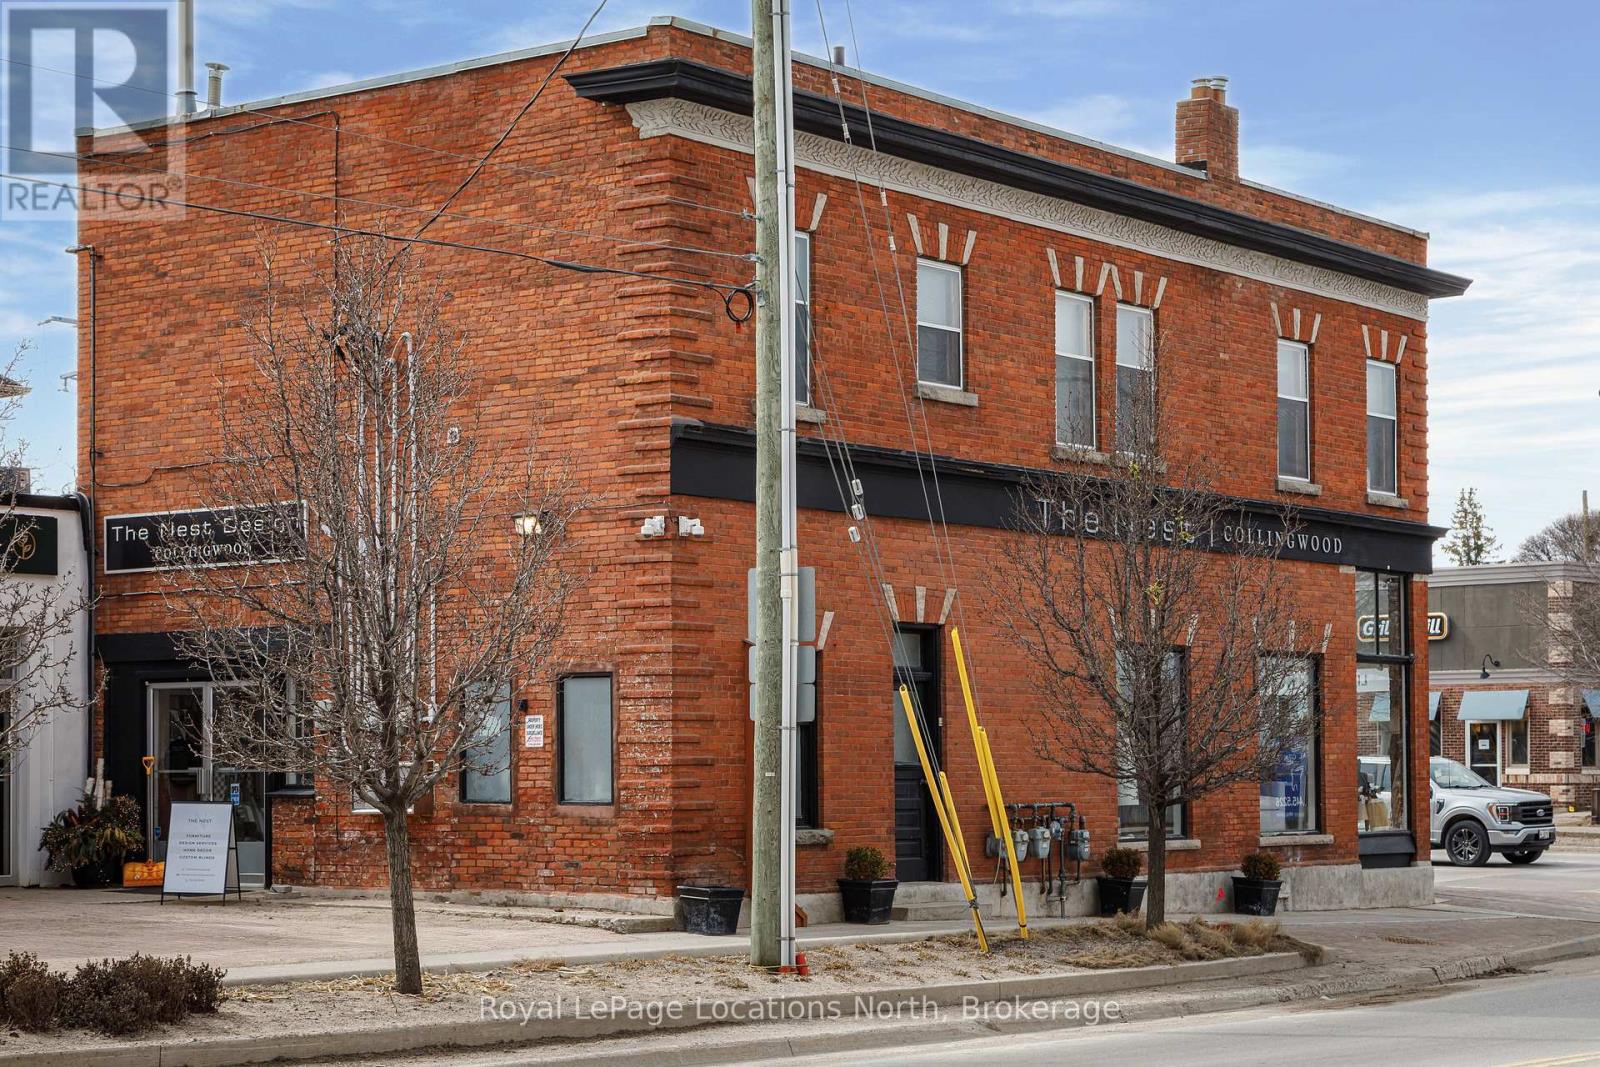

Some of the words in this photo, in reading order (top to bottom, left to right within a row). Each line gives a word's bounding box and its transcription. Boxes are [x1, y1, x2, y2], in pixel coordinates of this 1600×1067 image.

[111, 525, 149, 542] The
[160, 520, 213, 539] Nest
[223, 516, 299, 534] Desgn
[1037, 498, 1099, 534] The
[1223, 525, 1342, 553] COLLINGWOOD
